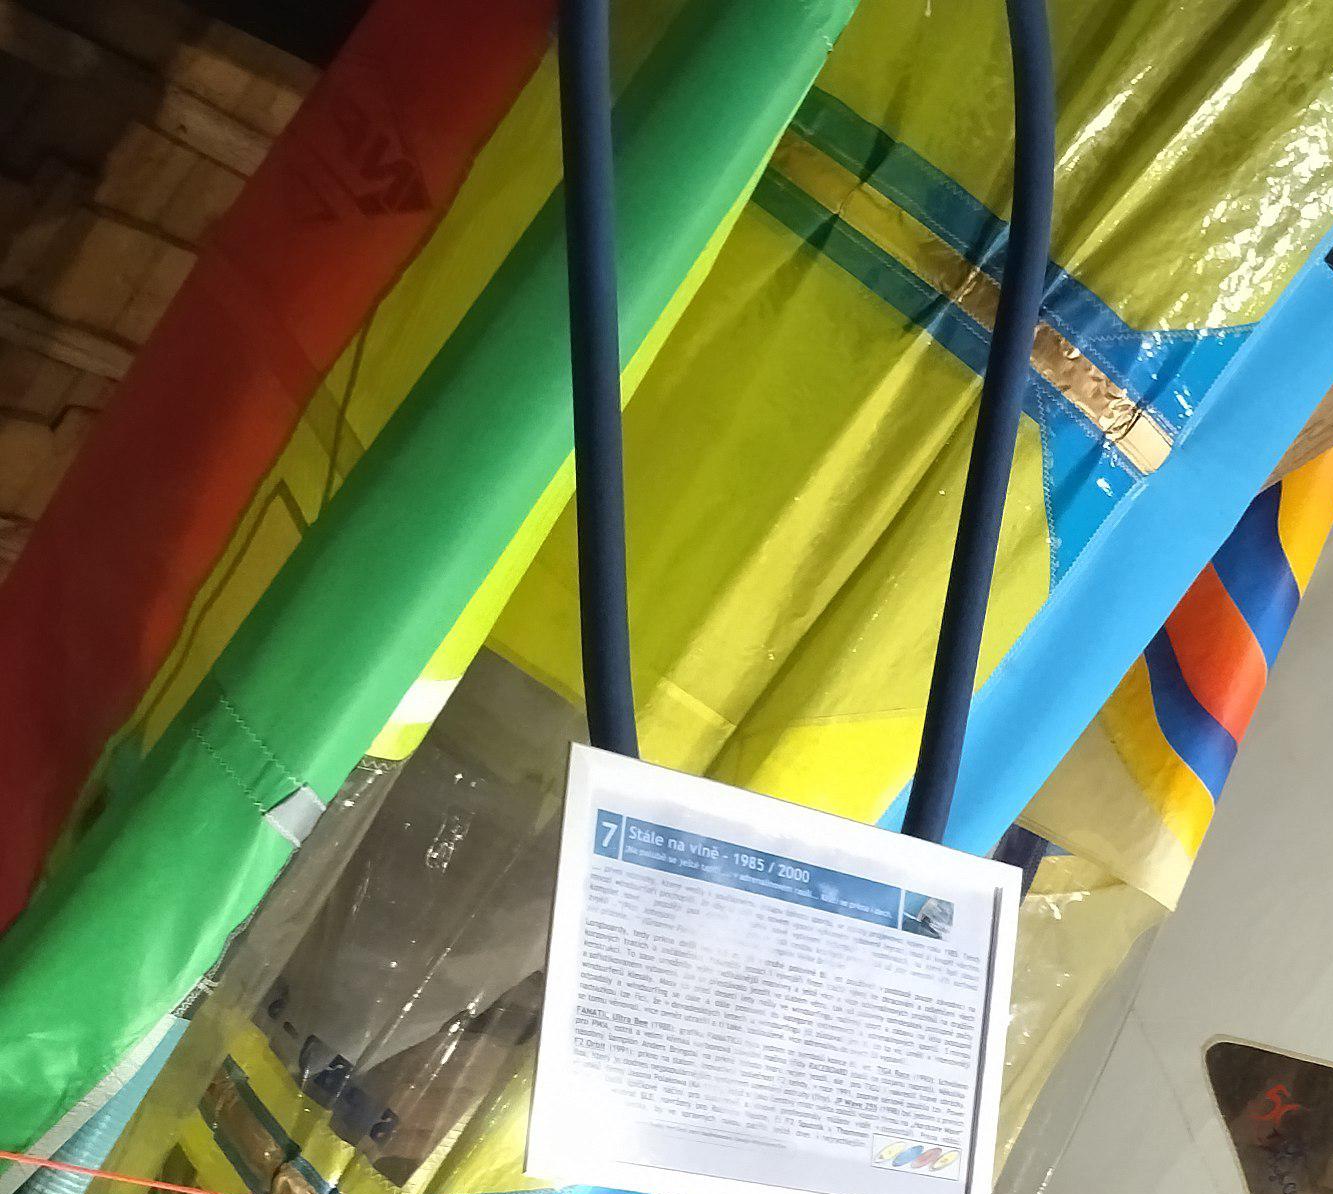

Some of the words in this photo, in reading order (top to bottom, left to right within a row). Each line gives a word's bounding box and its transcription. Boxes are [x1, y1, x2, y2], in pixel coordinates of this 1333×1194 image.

[601, 821, 618, 848] 7
[667, 837, 685, 852] na
[733, 852, 765, 873] 1985
[778, 862, 811, 884] 2000
